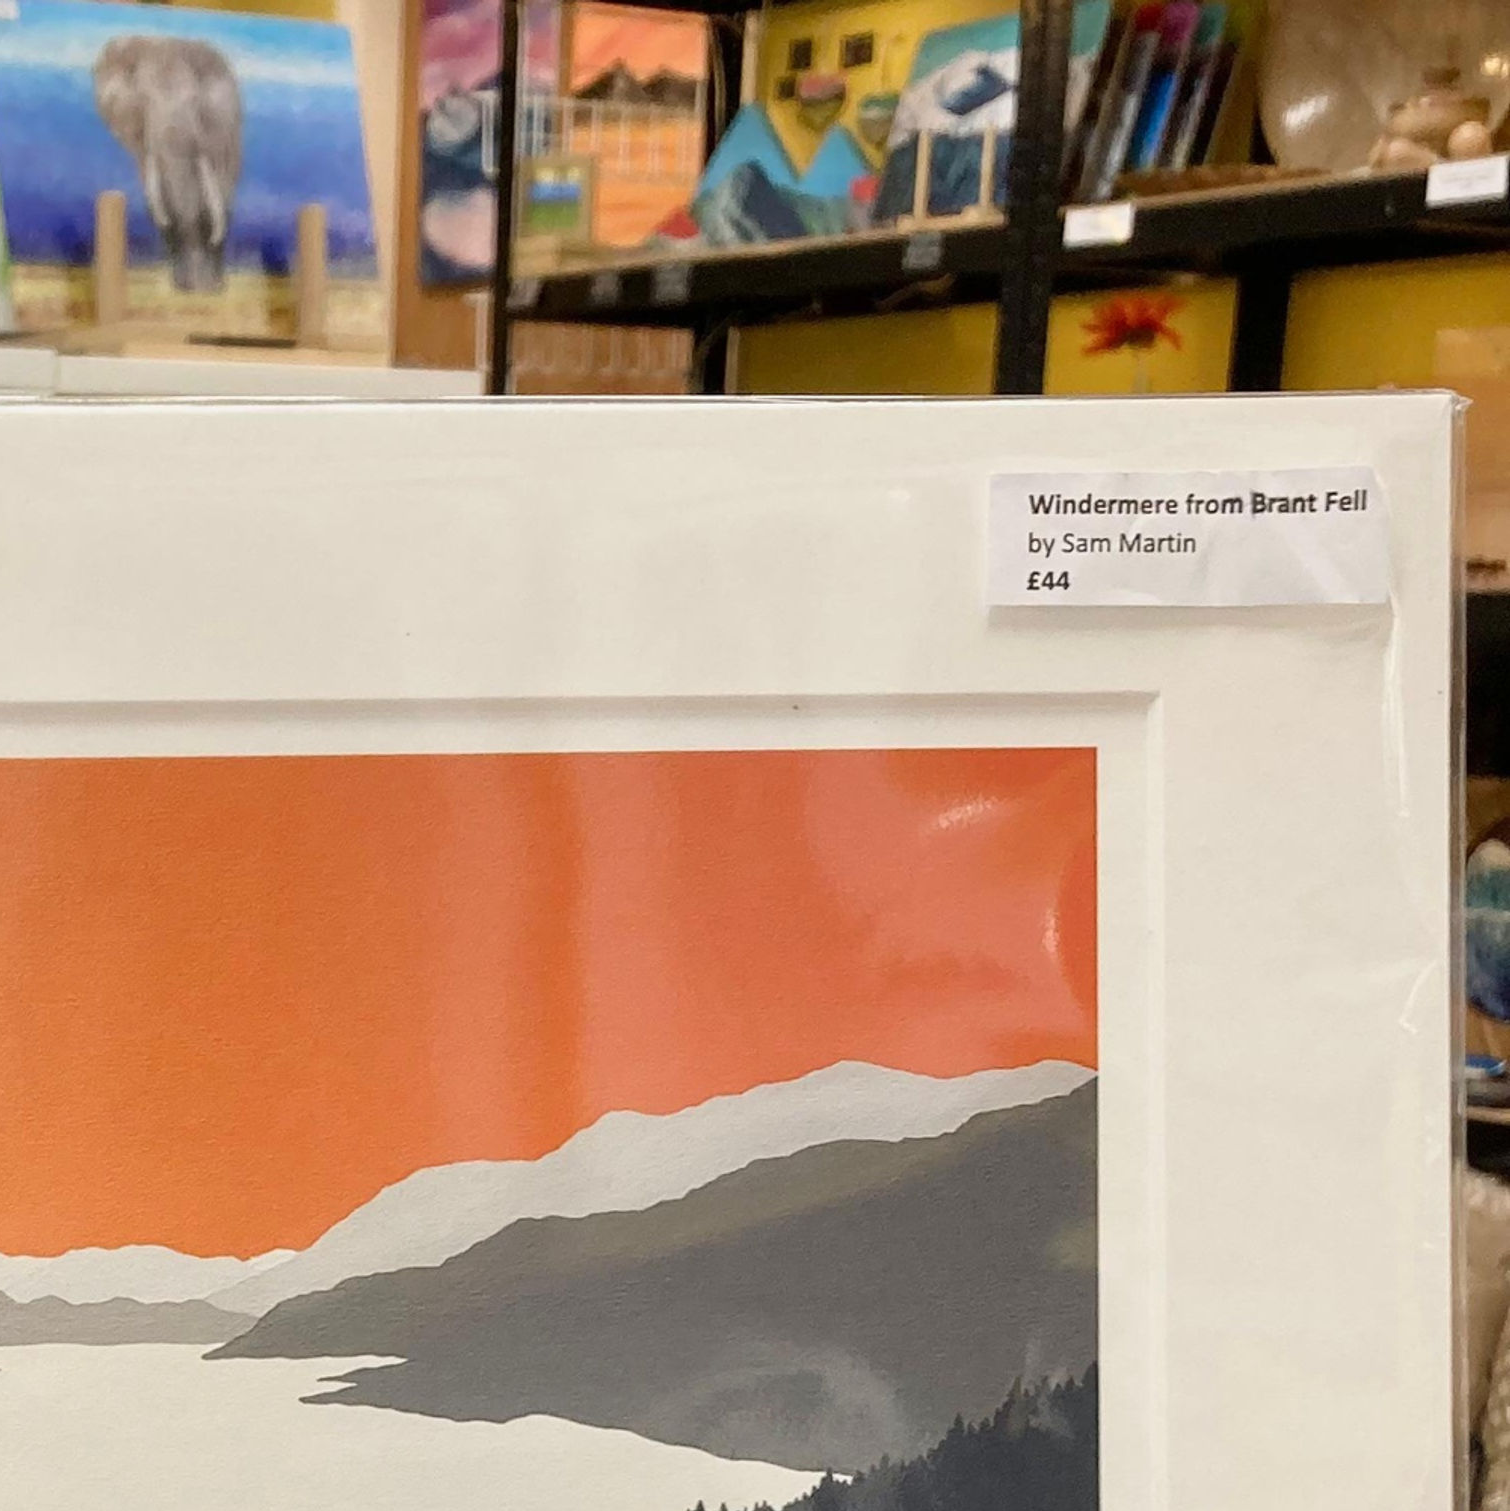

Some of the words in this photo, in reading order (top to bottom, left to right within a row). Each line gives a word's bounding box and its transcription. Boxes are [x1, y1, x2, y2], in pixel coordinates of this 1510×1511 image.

[1029, 493, 1178, 515] Windermere
[1186, 493, 1243, 515] from
[1251, 490, 1316, 516] Brant
[1325, 490, 1368, 512] Fell
[1028, 532, 1055, 558] by
[1062, 533, 1111, 553] Sam
[1119, 532, 1196, 553] Martin
[1026, 570, 1070, 591] £44
